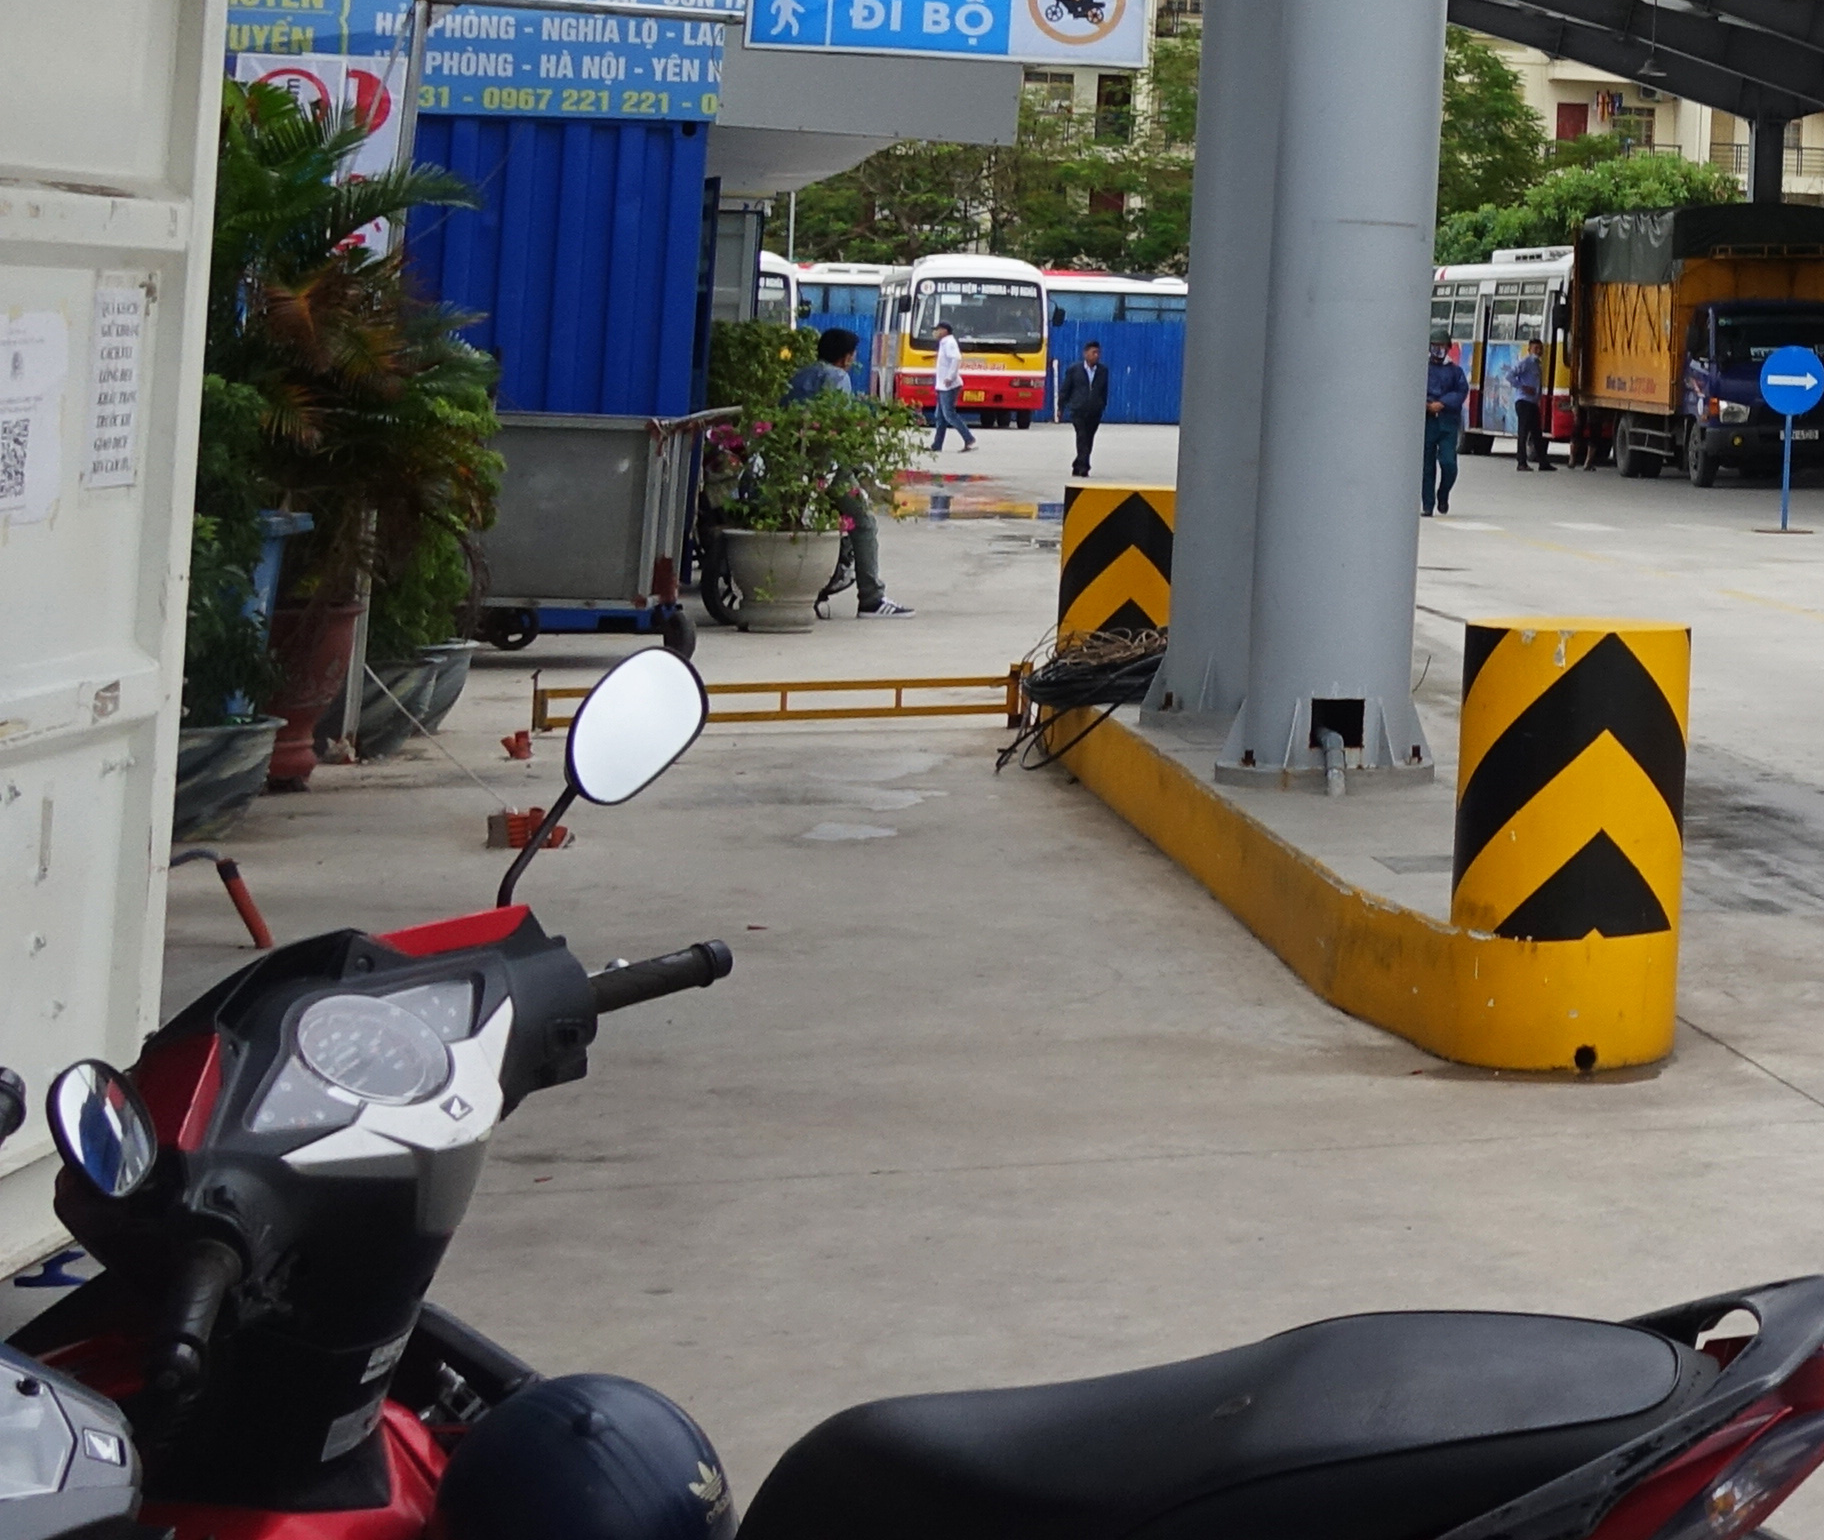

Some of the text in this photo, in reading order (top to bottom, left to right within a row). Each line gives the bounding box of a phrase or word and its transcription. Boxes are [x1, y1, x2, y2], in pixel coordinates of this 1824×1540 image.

[428, 9, 516, 40] PHÒNG
[425, 46, 514, 77] PHÒNG
[539, 50, 574, 78] HÀ
[582, 51, 626, 85] NỘI
[652, 54, 700, 82] YÊN
[483, 87, 553, 110] 0967
[561, 90, 610, 112] 221
[622, 91, 669, 114] 221
